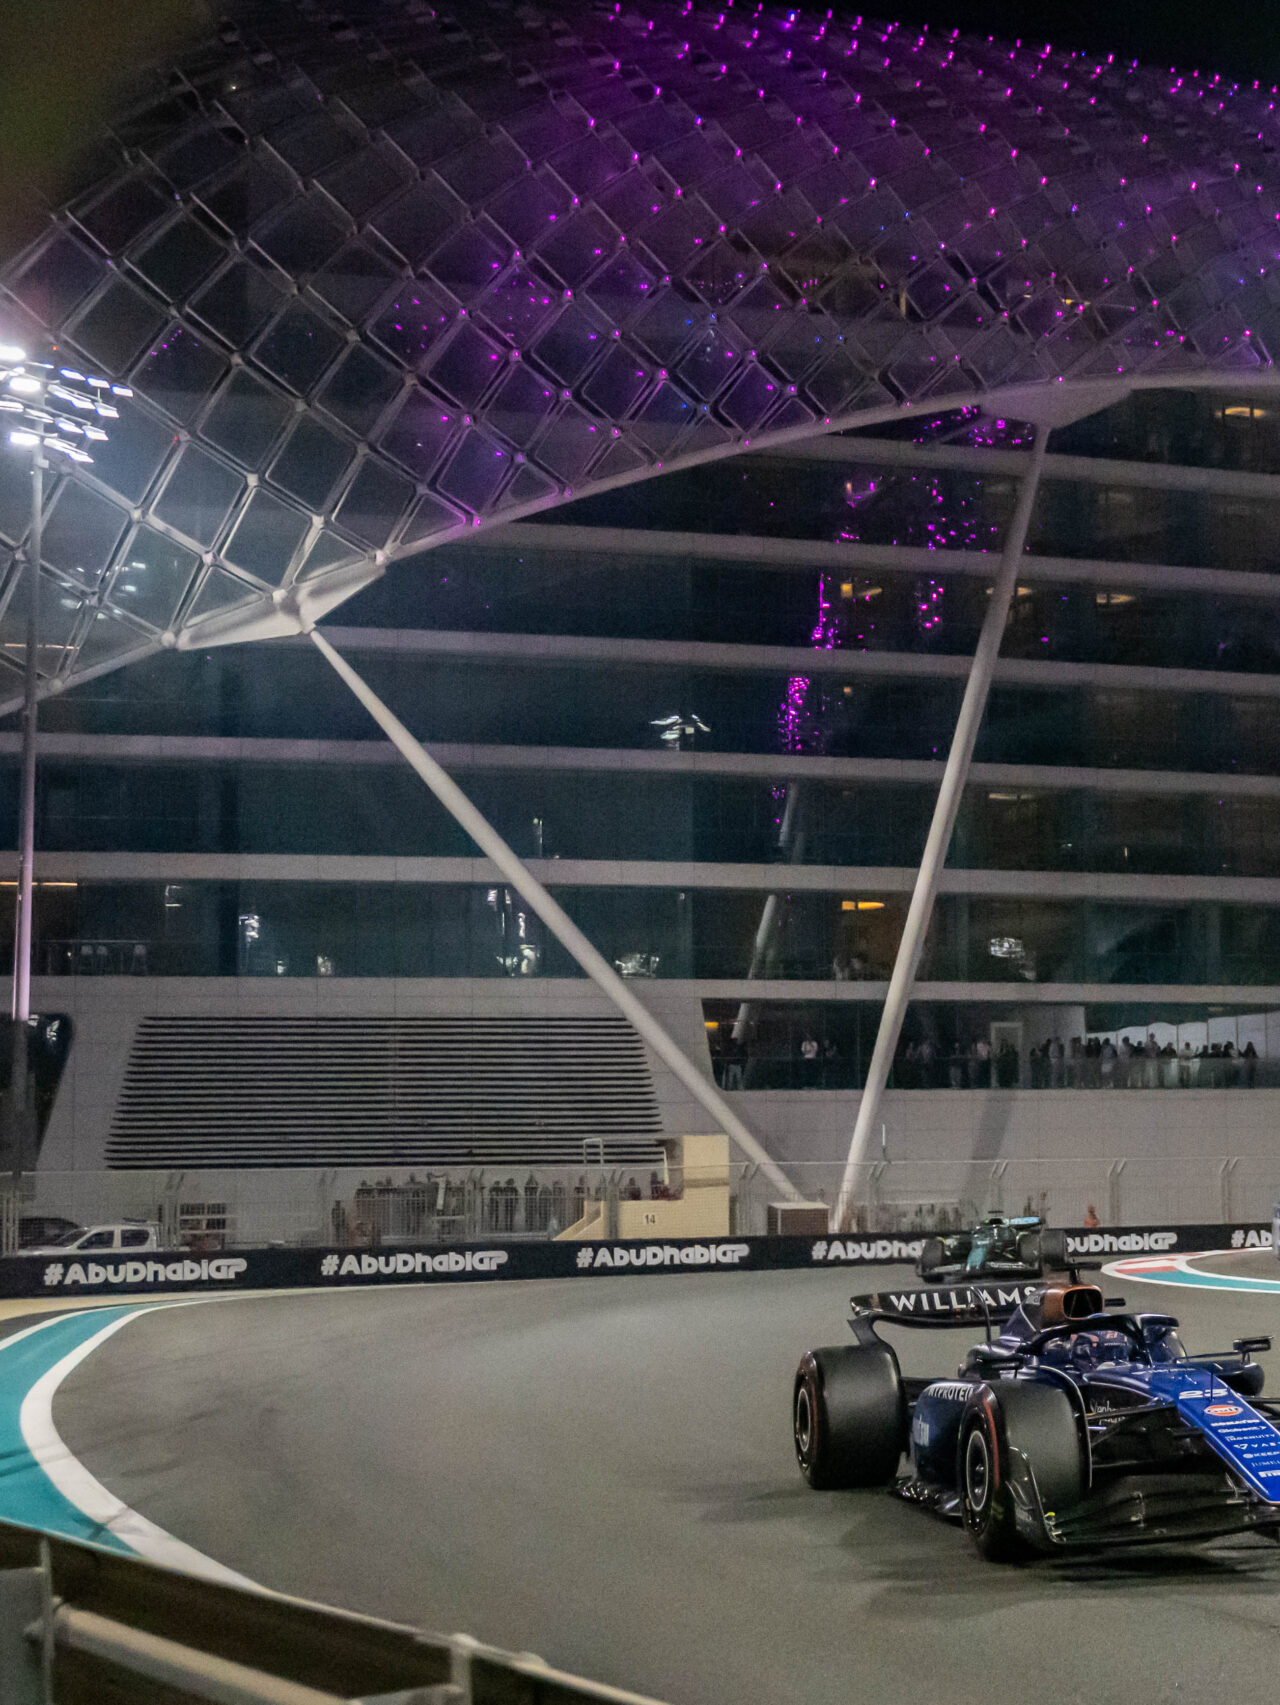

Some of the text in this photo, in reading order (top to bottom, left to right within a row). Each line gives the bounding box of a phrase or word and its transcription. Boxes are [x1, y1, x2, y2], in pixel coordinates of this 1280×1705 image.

[644, 1214, 656, 1224] 14
[321, 1250, 509, 1276] #AbuDhabiGP
[576, 1243, 751, 1268] #AbuDhabiGP
[43, 1257, 248, 1286] #AbuDhabiGP
